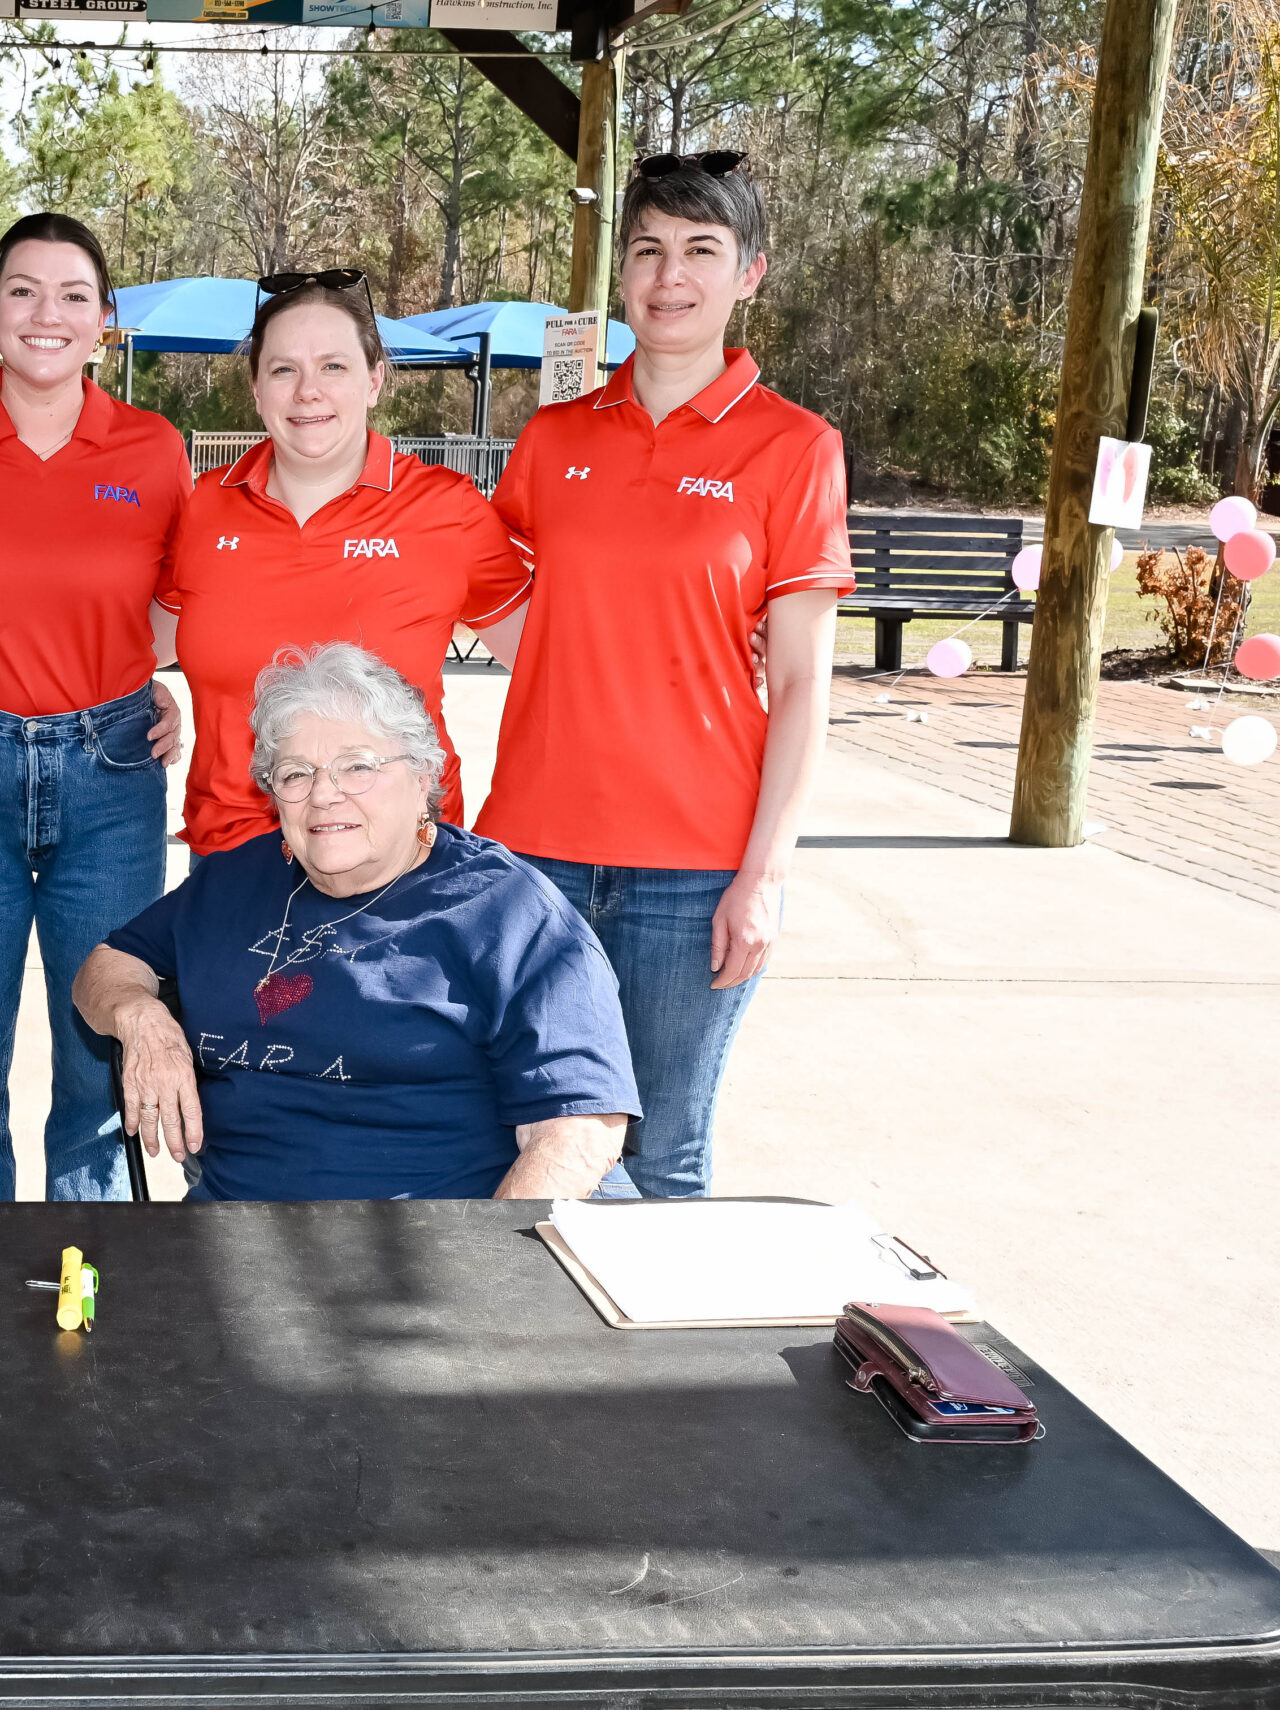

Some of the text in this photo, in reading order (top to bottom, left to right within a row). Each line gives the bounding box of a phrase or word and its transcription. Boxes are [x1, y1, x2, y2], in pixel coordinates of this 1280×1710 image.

[29, 0, 139, 10] STEEL GROUP
[477, 0, 535, 10] nstruction,
[537, 1, 553, 10] Inc.
[546, 320, 563, 328] PULL
[578, 317, 597, 325] CURE
[561, 328, 577, 336] FARA
[676, 476, 734, 503] FARA
[94, 484, 141, 507] FARA
[343, 538, 400, 559] FARA
